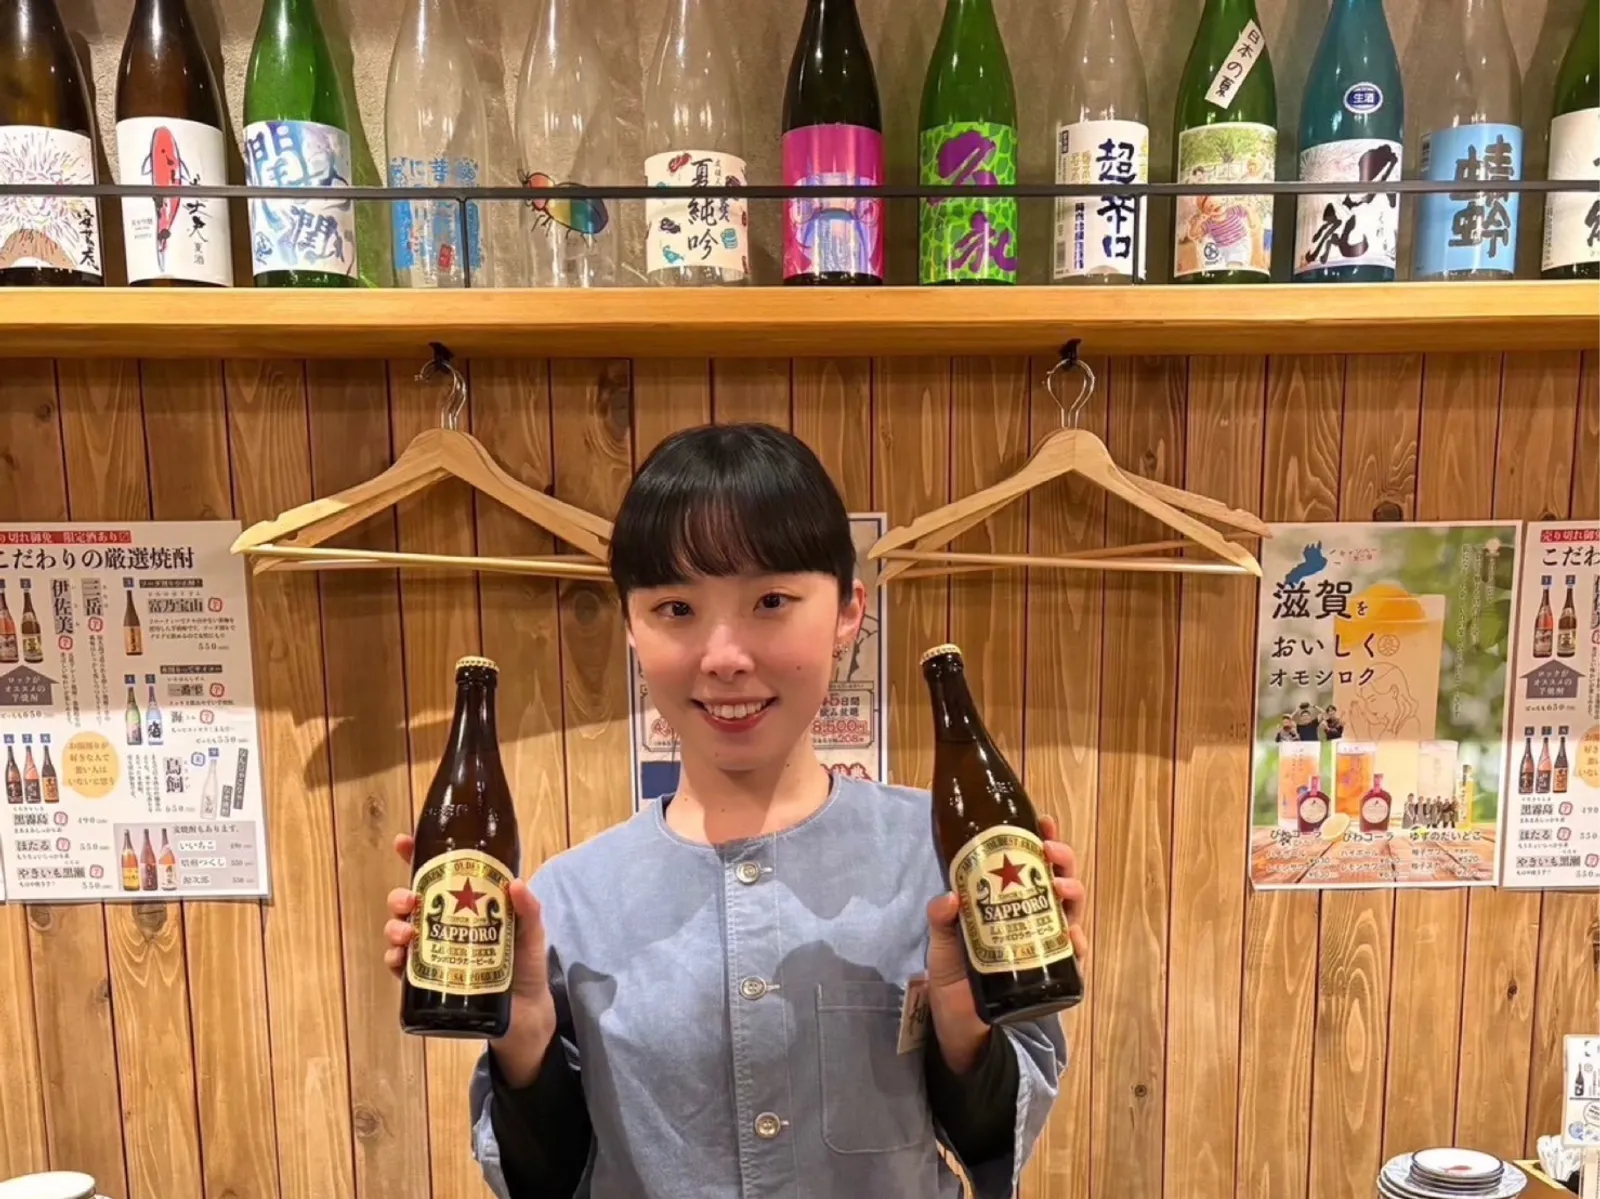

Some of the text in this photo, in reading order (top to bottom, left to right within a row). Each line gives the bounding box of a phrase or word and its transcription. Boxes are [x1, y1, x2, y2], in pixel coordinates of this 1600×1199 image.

[1216, 28, 1260, 98] 日本の夏
[1353, 93, 1375, 103] 生酒
[83, 579, 102, 616] 三岳
[1272, 579, 1369, 619] 滋賀を
[52, 580, 74, 634] 伊佐美
[149, 599, 203, 613] 富乃宝山
[1272, 633, 1376, 658] おいしく
[8, 675, 41, 683] ロックが
[1270, 667, 1376, 687] オモシロク
[1538, 669, 1569, 677] ロックが
[1533, 678, 1572, 686] オススメの
[5, 684, 46, 693] オススメの
[1520, 804, 1553, 815] 黒霧島
[14, 813, 49, 826] 黒霧島
[1343, 831, 1394, 842] びわコーラ
[1519, 829, 1551, 840] ほたる
[17, 840, 50, 852] ほたる
[180, 841, 215, 850] いいちこ
[1516, 856, 1581, 867] やきいも黒瀬
[18, 867, 86, 879] やきいも黒瀬
[985, 895, 1049, 921] SAPPORO
[430, 923, 497, 942] SAPPORO
